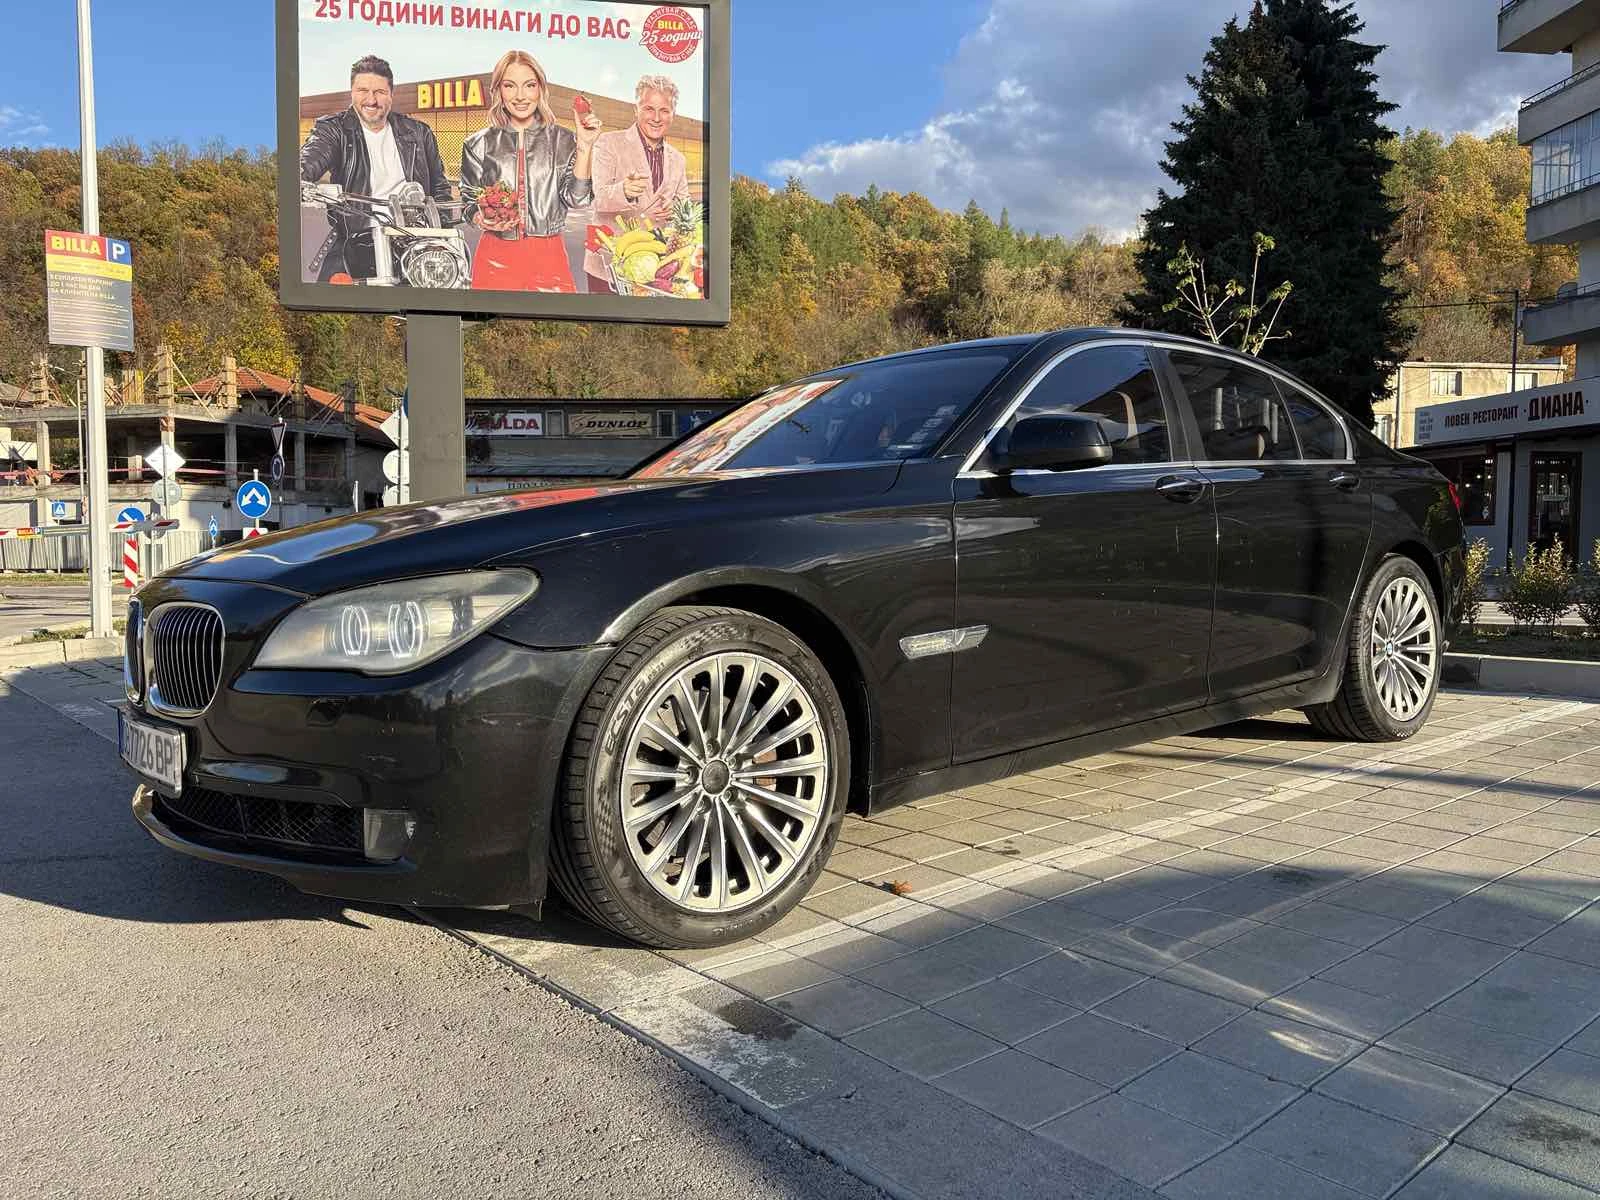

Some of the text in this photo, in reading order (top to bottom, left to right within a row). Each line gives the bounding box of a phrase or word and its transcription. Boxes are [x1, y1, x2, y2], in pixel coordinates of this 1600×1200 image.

[315, 0, 630, 39] 25 ГОДИНИ ВИНАГИ ДО ВАС
[657, 20, 684, 30] BILLA
[639, 30, 660, 45] 25
[417, 80, 484, 109] BILLA
[50, 236, 125, 260] BILLA P
[1444, 391, 1584, 428] ЛОВЕН РЕСТОРАНТ ДИАНА
[585, 420, 648, 428] DUNLOP
